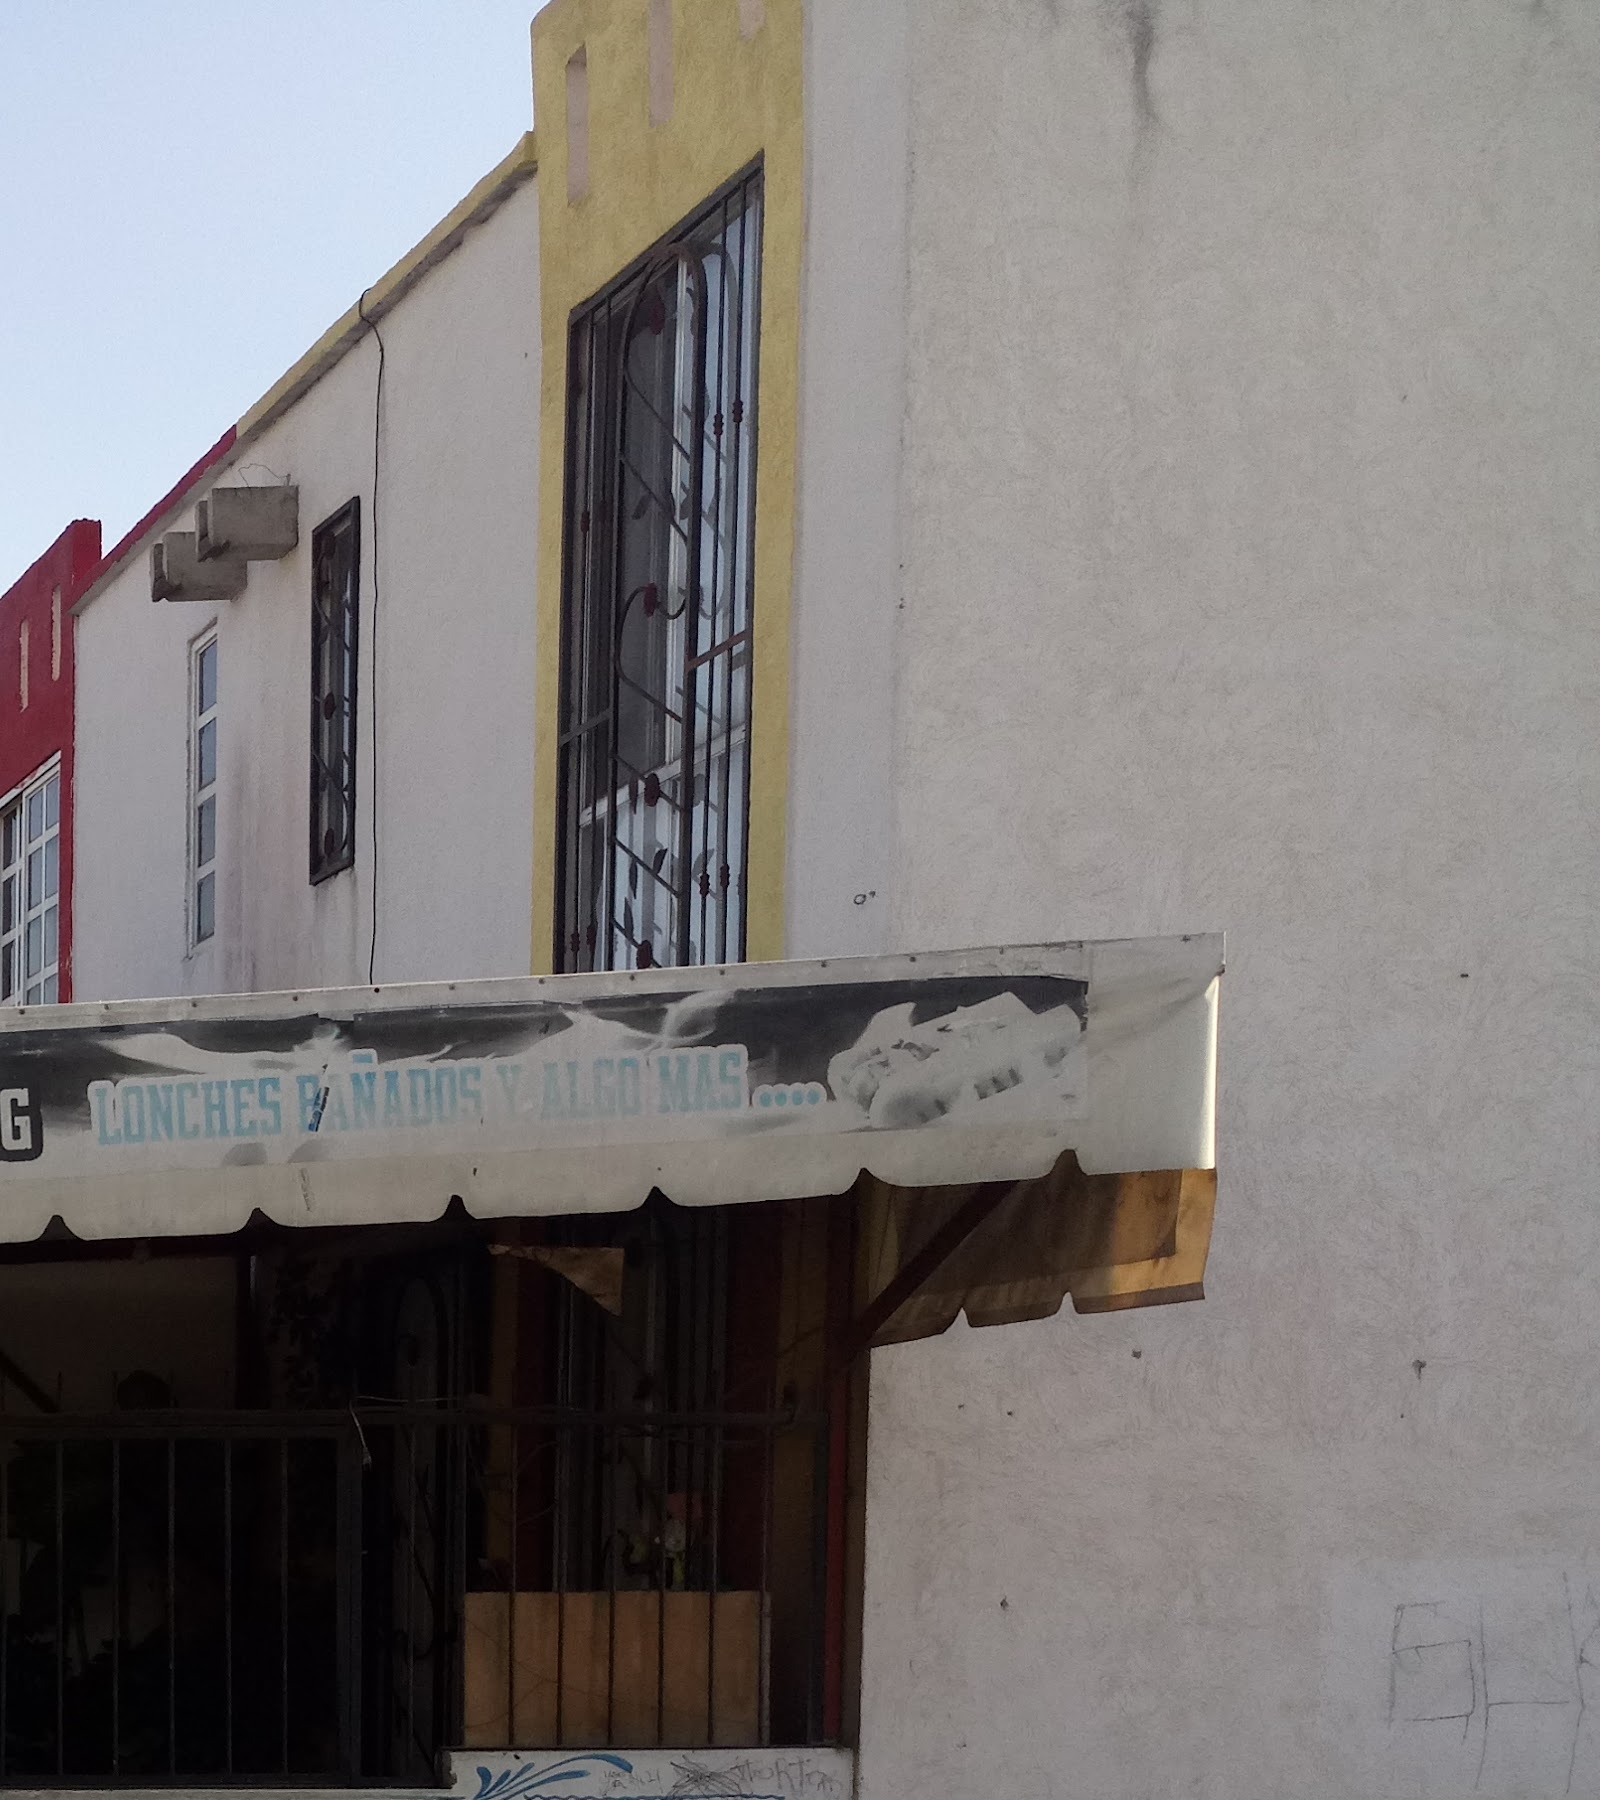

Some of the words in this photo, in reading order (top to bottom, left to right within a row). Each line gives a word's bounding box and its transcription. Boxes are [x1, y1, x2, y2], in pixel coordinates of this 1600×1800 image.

[96, 1076, 282, 1145] LONCHES
[497, 1063, 522, 1125] Y
[541, 1057, 640, 1120] ALGO
